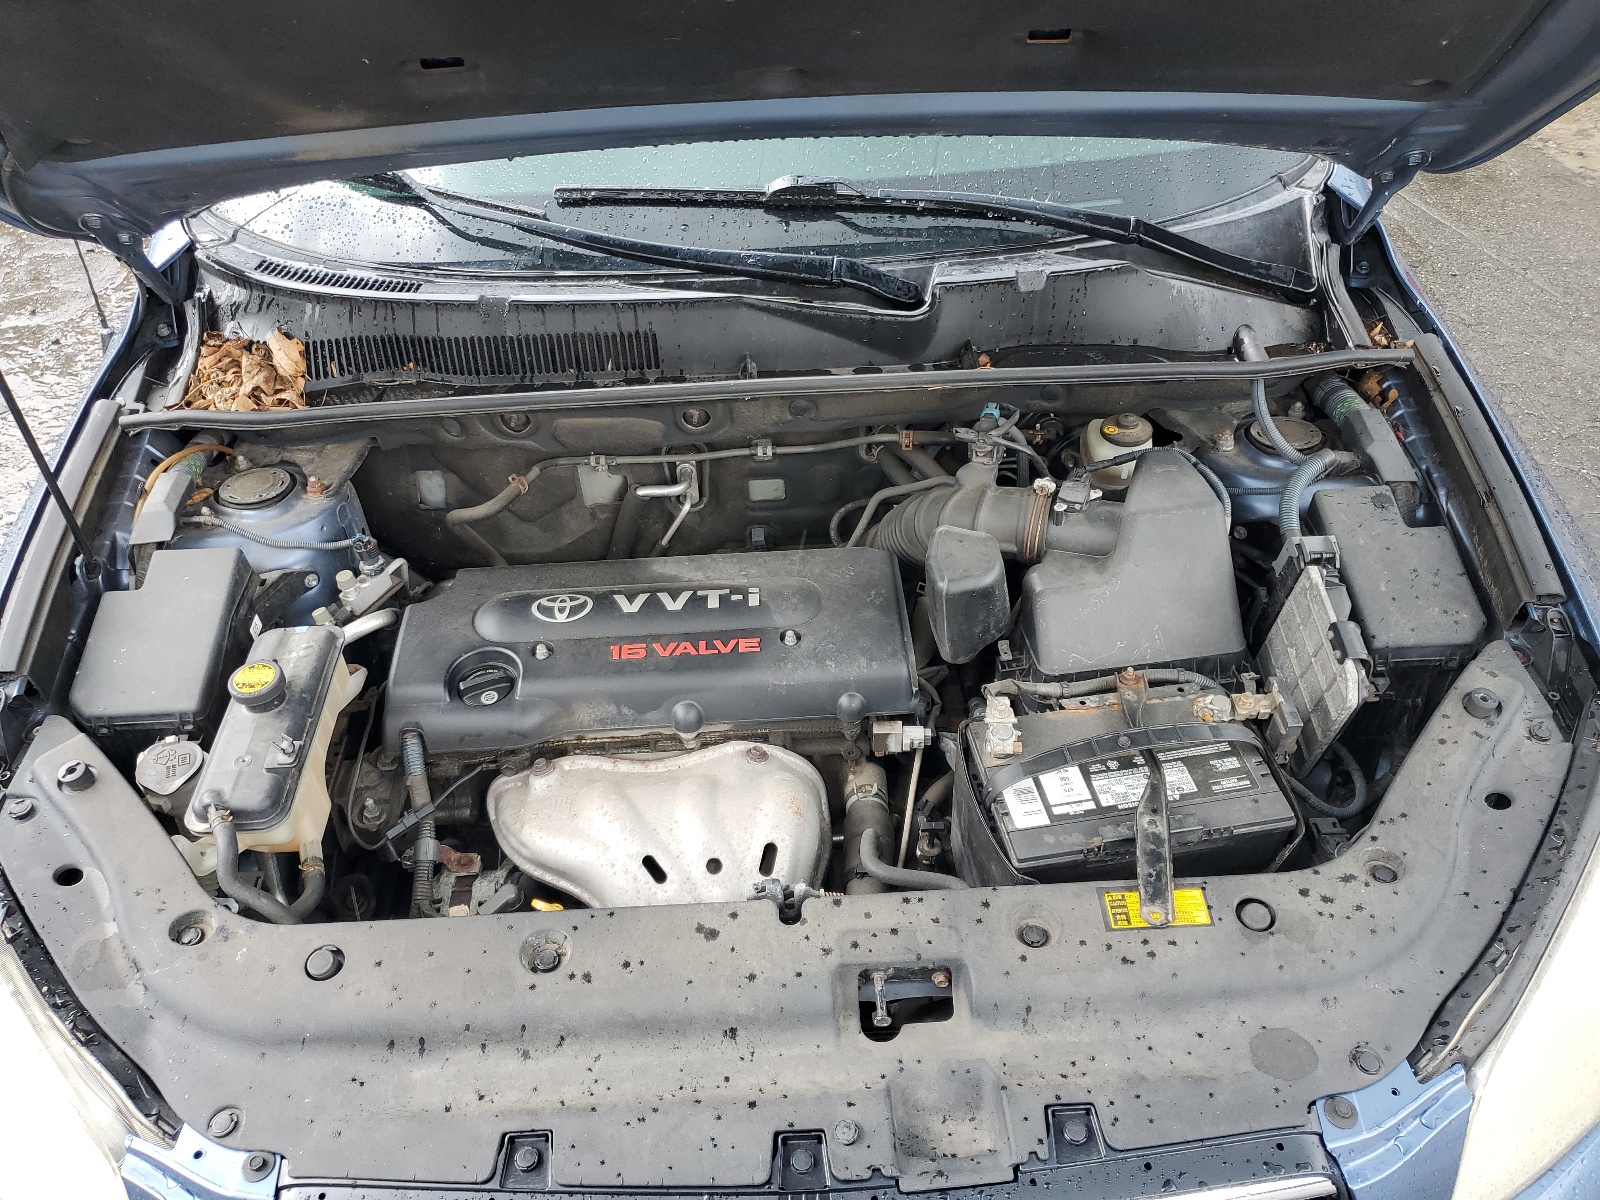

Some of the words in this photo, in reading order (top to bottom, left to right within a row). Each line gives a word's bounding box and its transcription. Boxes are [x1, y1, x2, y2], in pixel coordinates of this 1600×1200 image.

[613, 588, 760, 613] VVT-i
[611, 643, 647, 660] 16
[652, 637, 761, 657] VALVE
